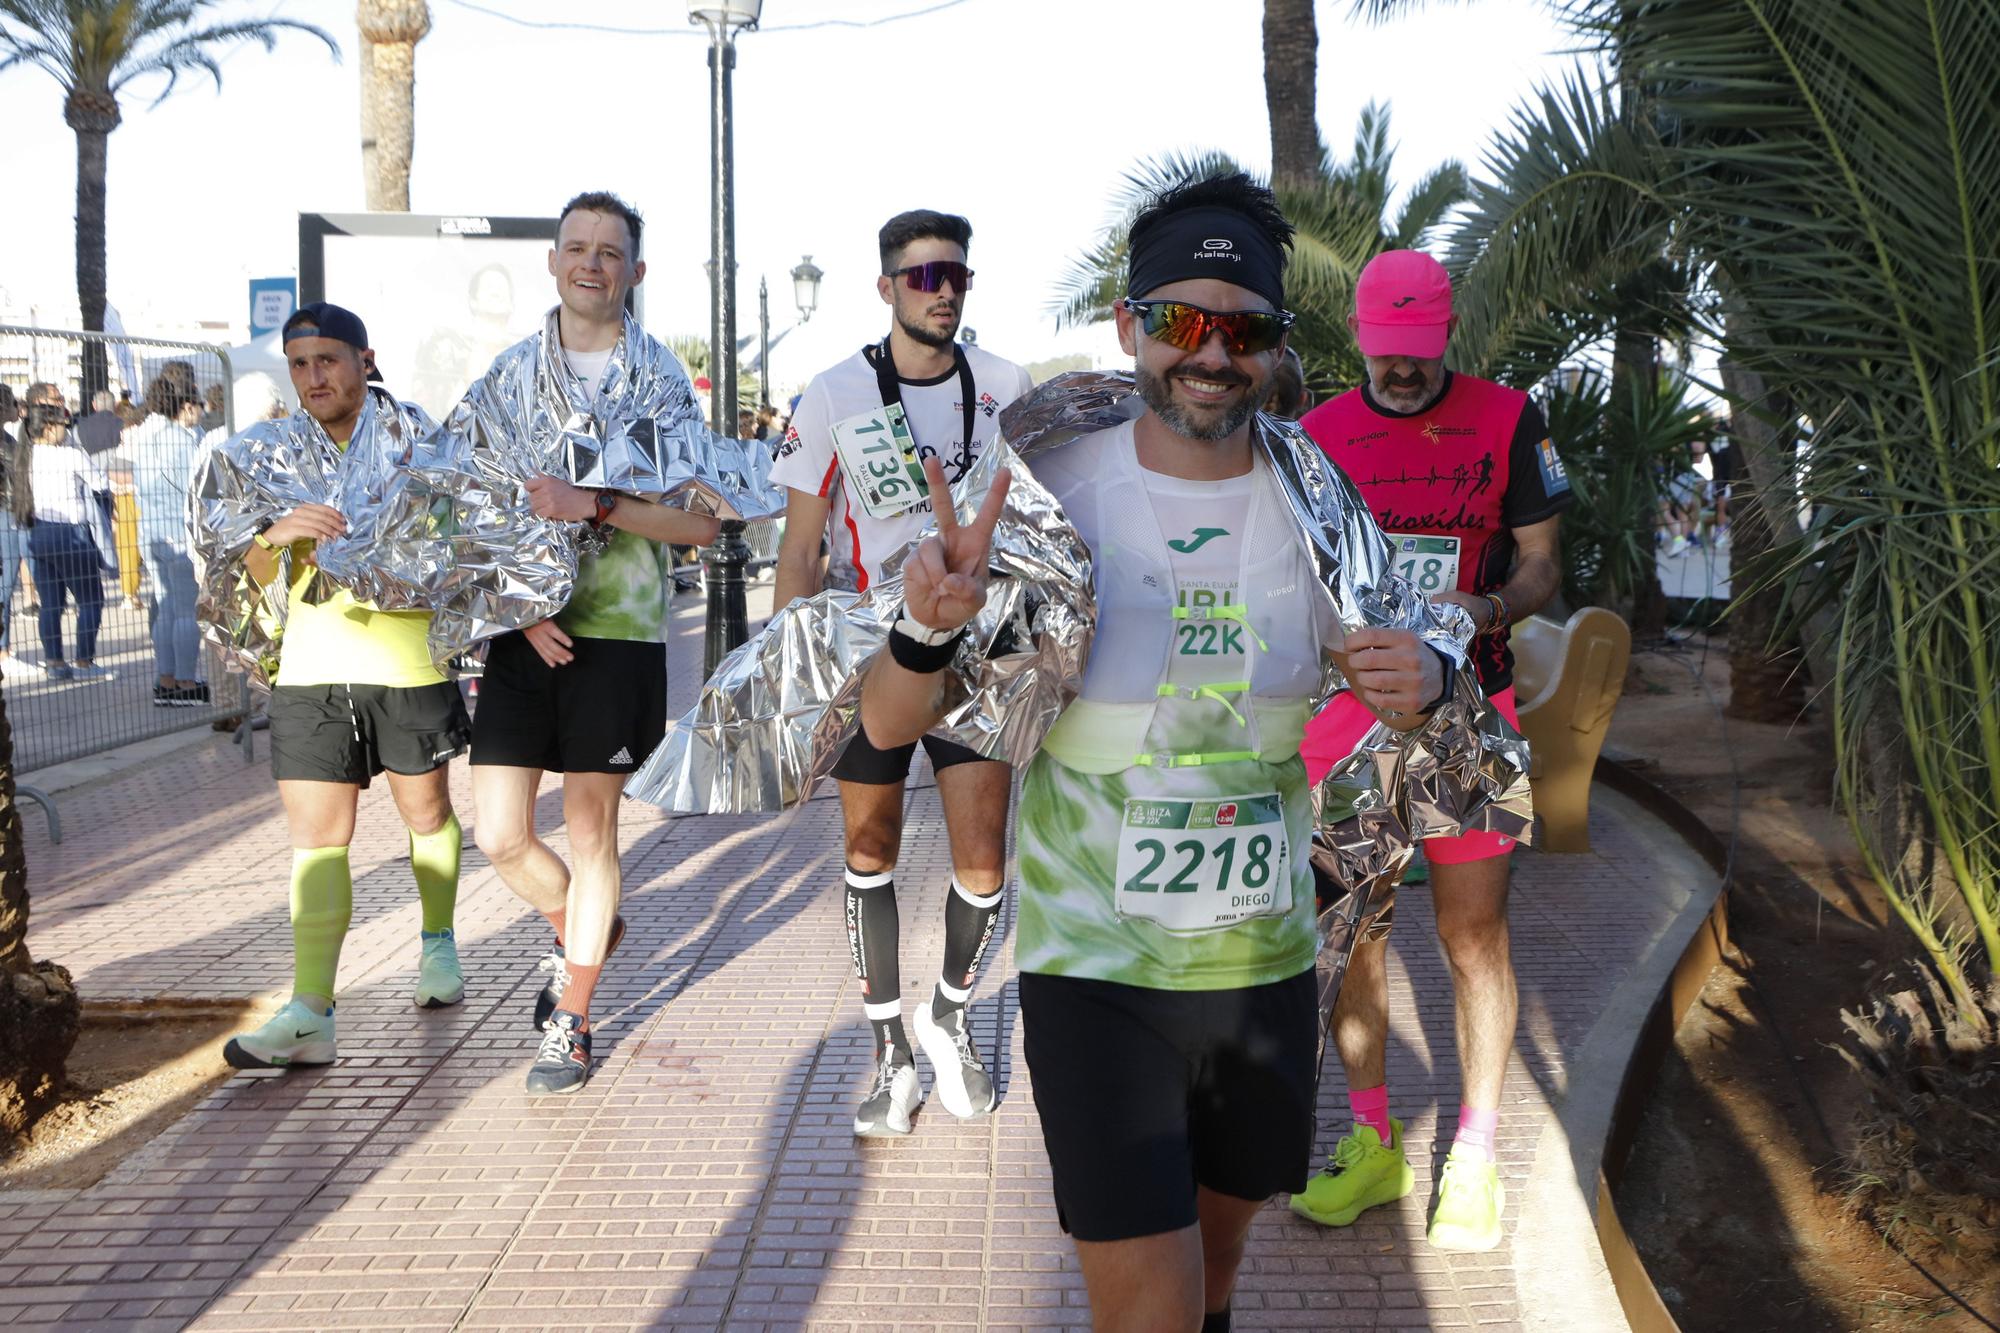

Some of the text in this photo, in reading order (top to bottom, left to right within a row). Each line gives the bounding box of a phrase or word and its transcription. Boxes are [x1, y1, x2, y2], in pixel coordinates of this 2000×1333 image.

[855, 418, 911, 498] 1136
[1180, 580, 1210, 588] SANTA
[1179, 624, 1245, 655] 22K
[1146, 807, 1171, 818] IBIZA
[1123, 834, 1272, 893] 2218
[1231, 893, 1270, 907] DIEGO
